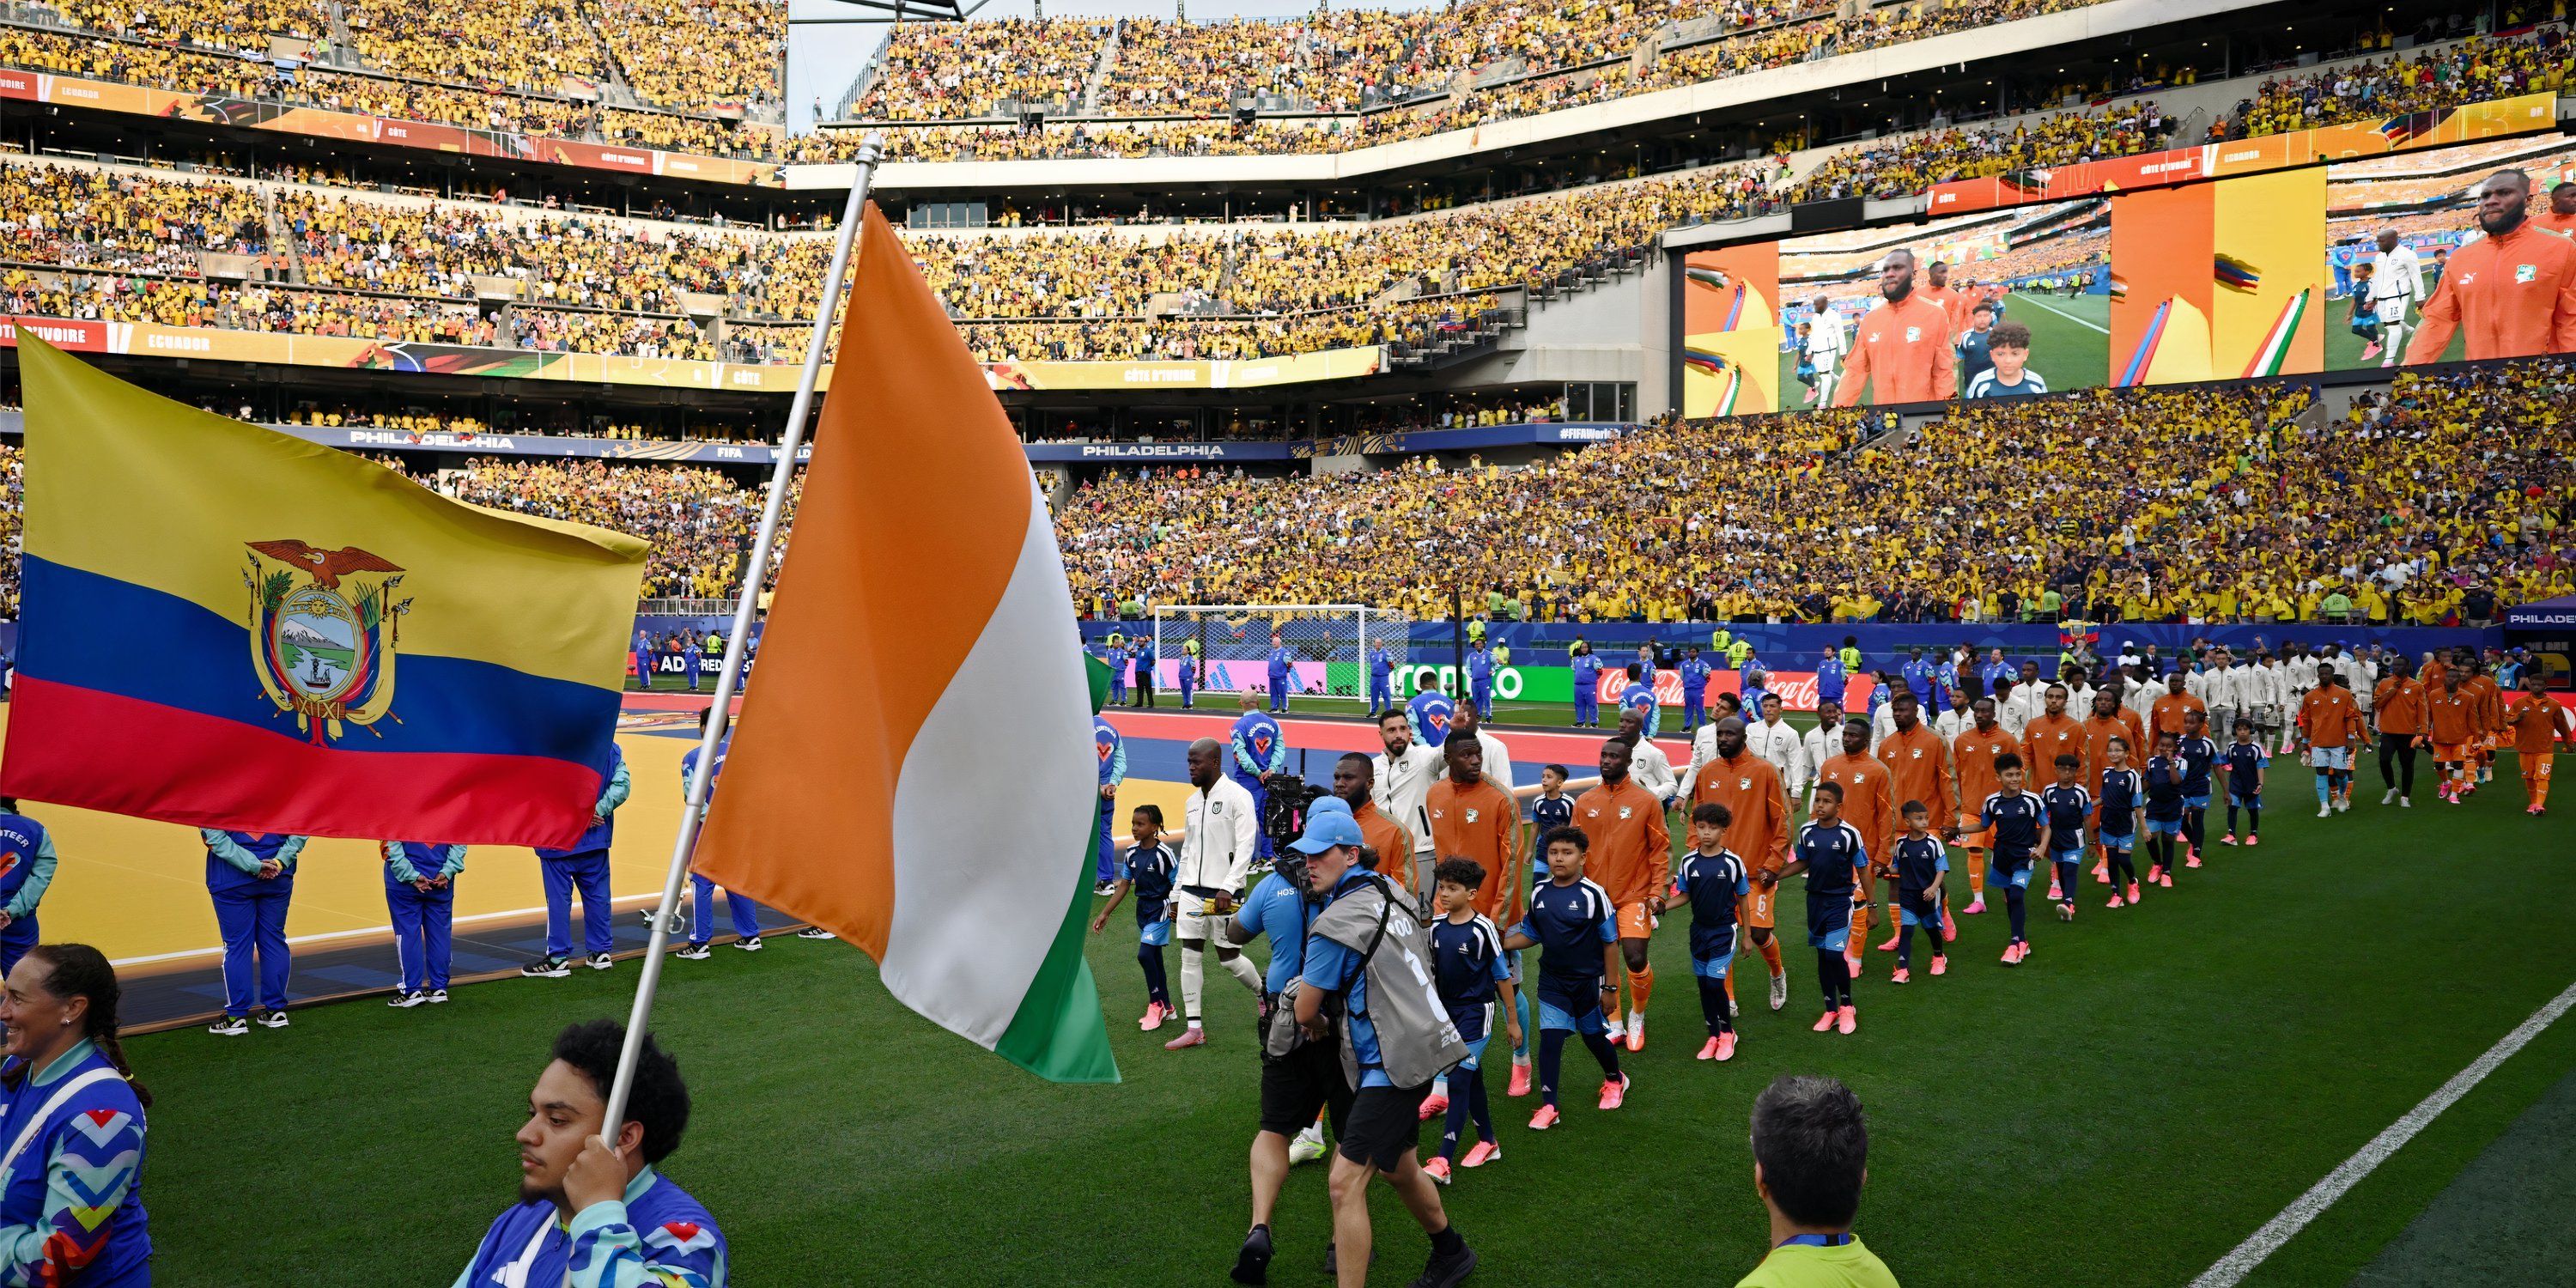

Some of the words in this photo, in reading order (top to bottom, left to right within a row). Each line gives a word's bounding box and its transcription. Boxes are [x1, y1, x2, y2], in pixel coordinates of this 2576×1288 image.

[148, 333, 210, 351] ECUADOR
[717, 447, 743, 459] FIFA
[770, 448, 811, 459] WLD
[1084, 445, 1225, 456] PHILADELPHIA
[2510, 615, 2576, 623] PHILADE
[1094, 725, 1116, 739] LUNTEER
[1248, 722, 1276, 738] VOLUNTEER
[1636, 902, 1646, 920] 3
[1758, 894, 1767, 913] 6
